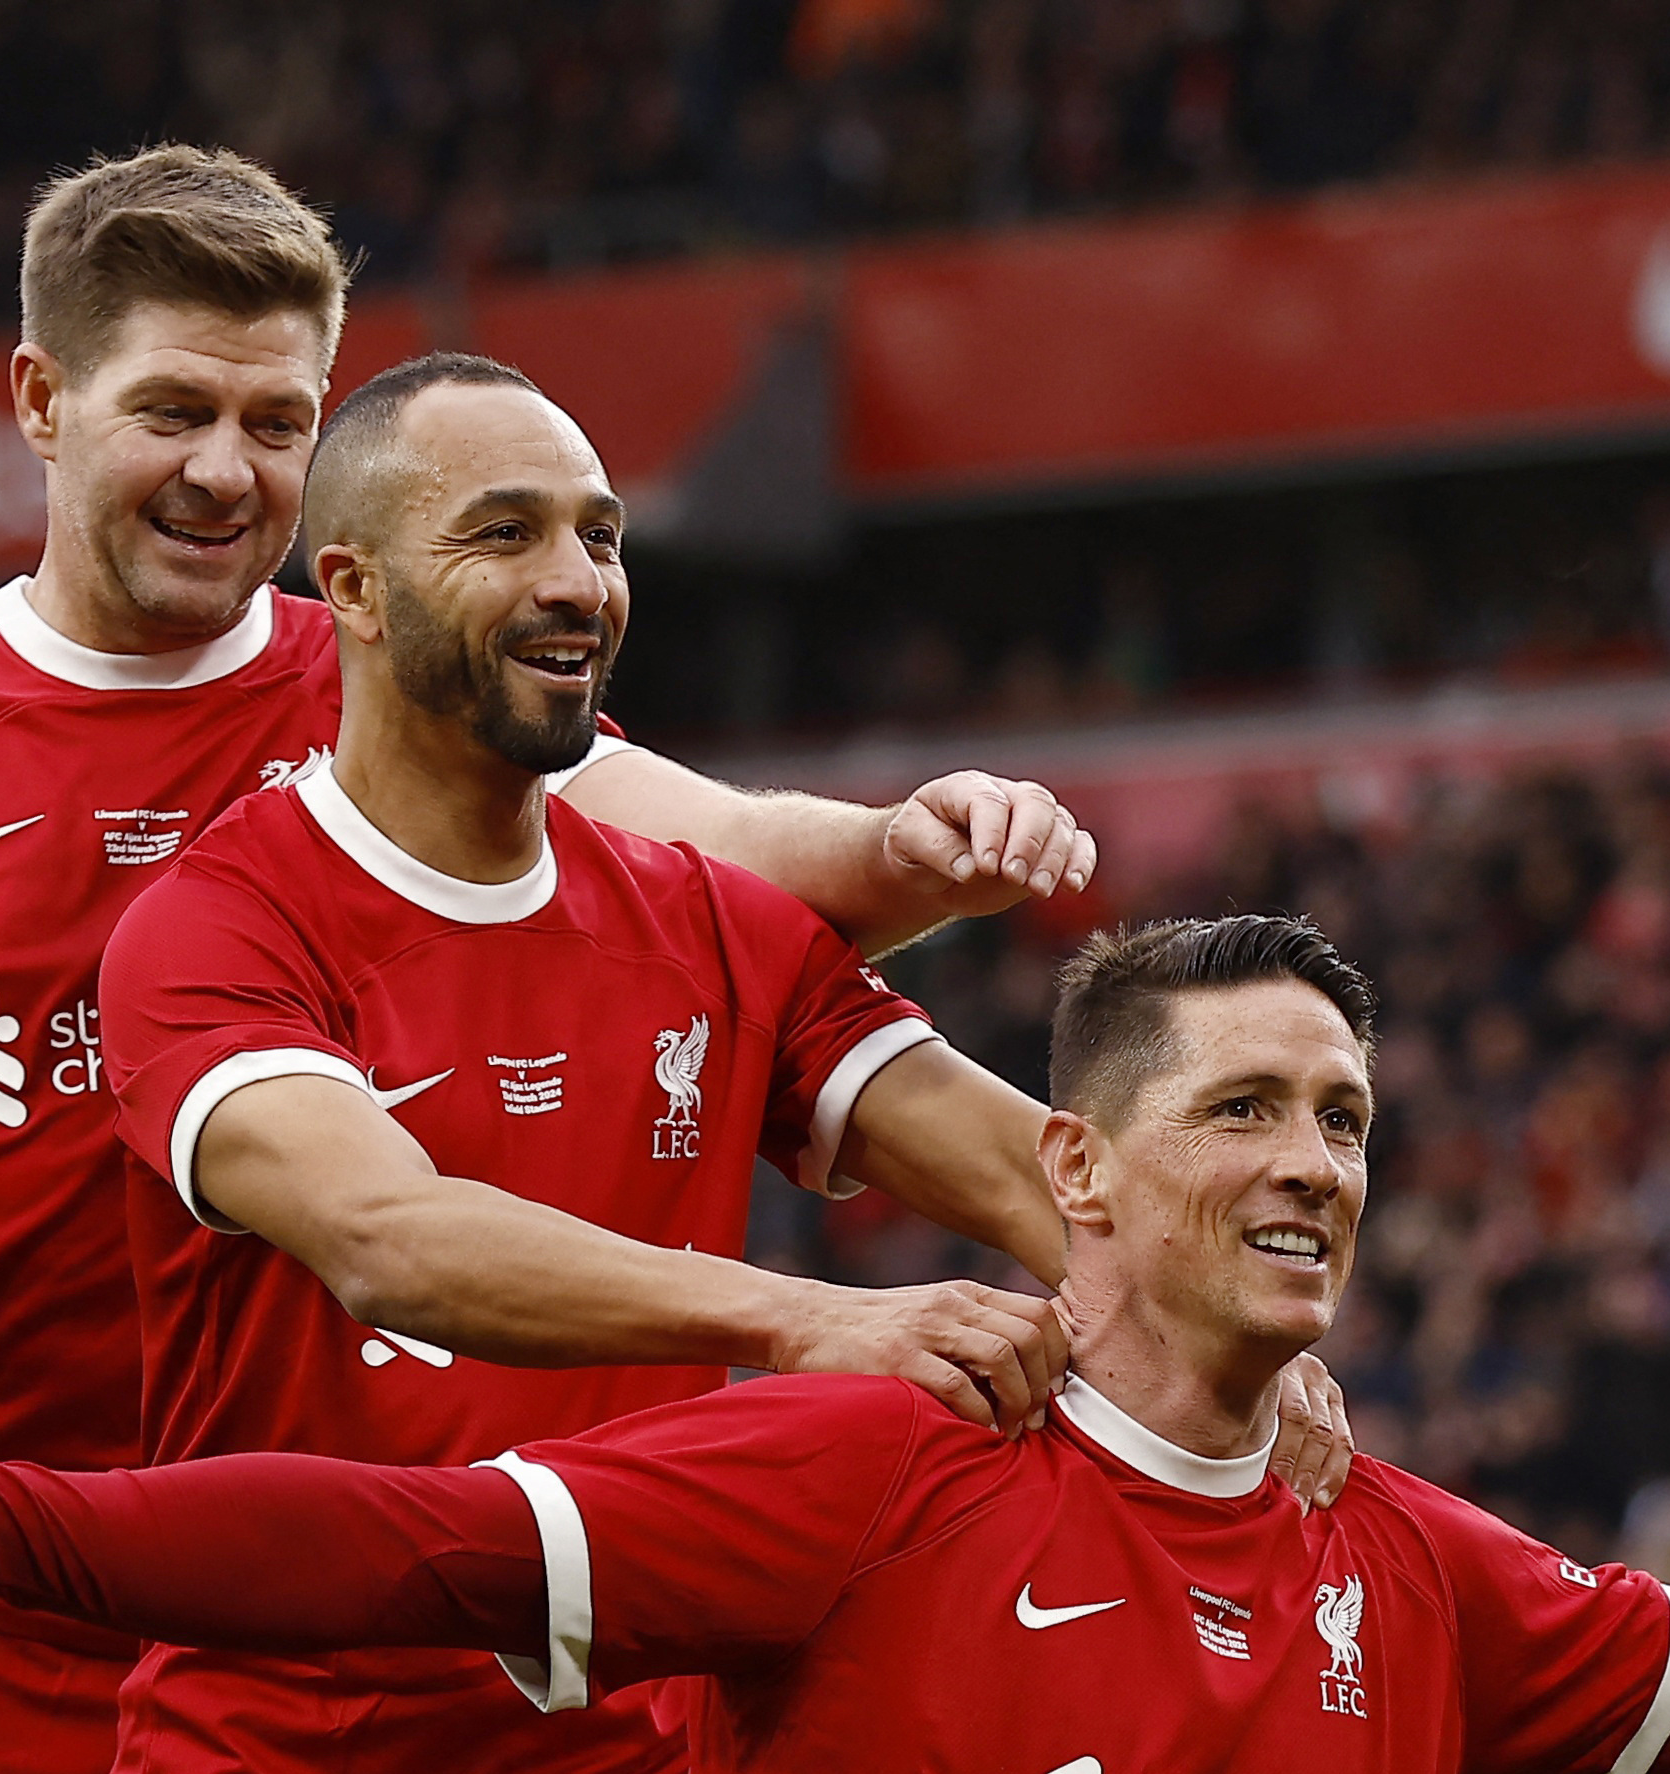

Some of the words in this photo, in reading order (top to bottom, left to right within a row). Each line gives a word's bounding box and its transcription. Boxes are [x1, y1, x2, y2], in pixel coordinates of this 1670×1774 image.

[138, 809, 150, 819] FC
[103, 832, 123, 841] AFC
[105, 843, 127, 853] 23rd
[516, 1059, 528, 1068] FC
[528, 1052, 567, 1068] Legends
[524, 1076, 562, 1091] Legends
[538, 1087, 562, 1100] 2024
[1189, 1586, 1223, 1606] Liverpool
[1221, 1599, 1232, 1610] FC
[1218, 1624, 1247, 1641] Legends
